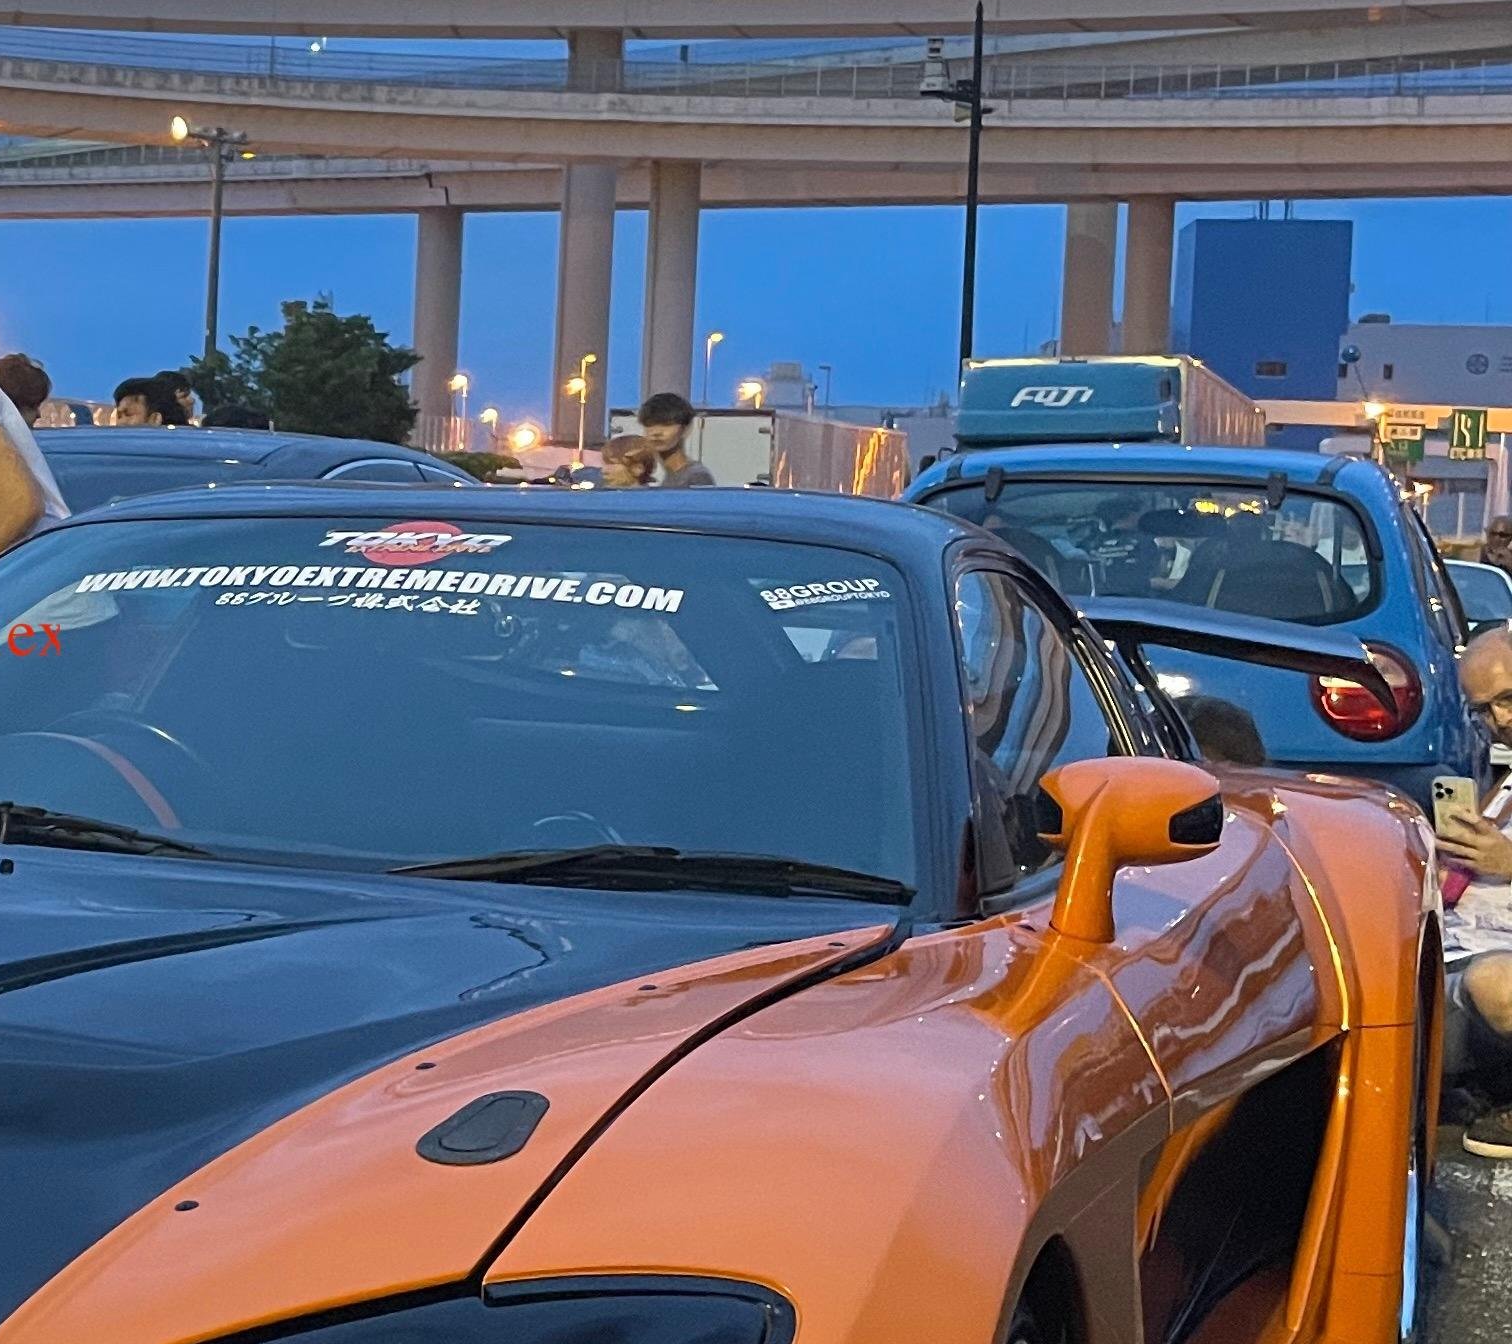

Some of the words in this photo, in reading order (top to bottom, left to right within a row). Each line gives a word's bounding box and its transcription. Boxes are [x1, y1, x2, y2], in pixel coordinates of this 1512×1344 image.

[318, 531, 513, 548] TOKYO
[75, 566, 685, 613] WWW.TOKYOEXTREMEDRIVE.COM
[760, 578, 880, 602] 88GROUP
